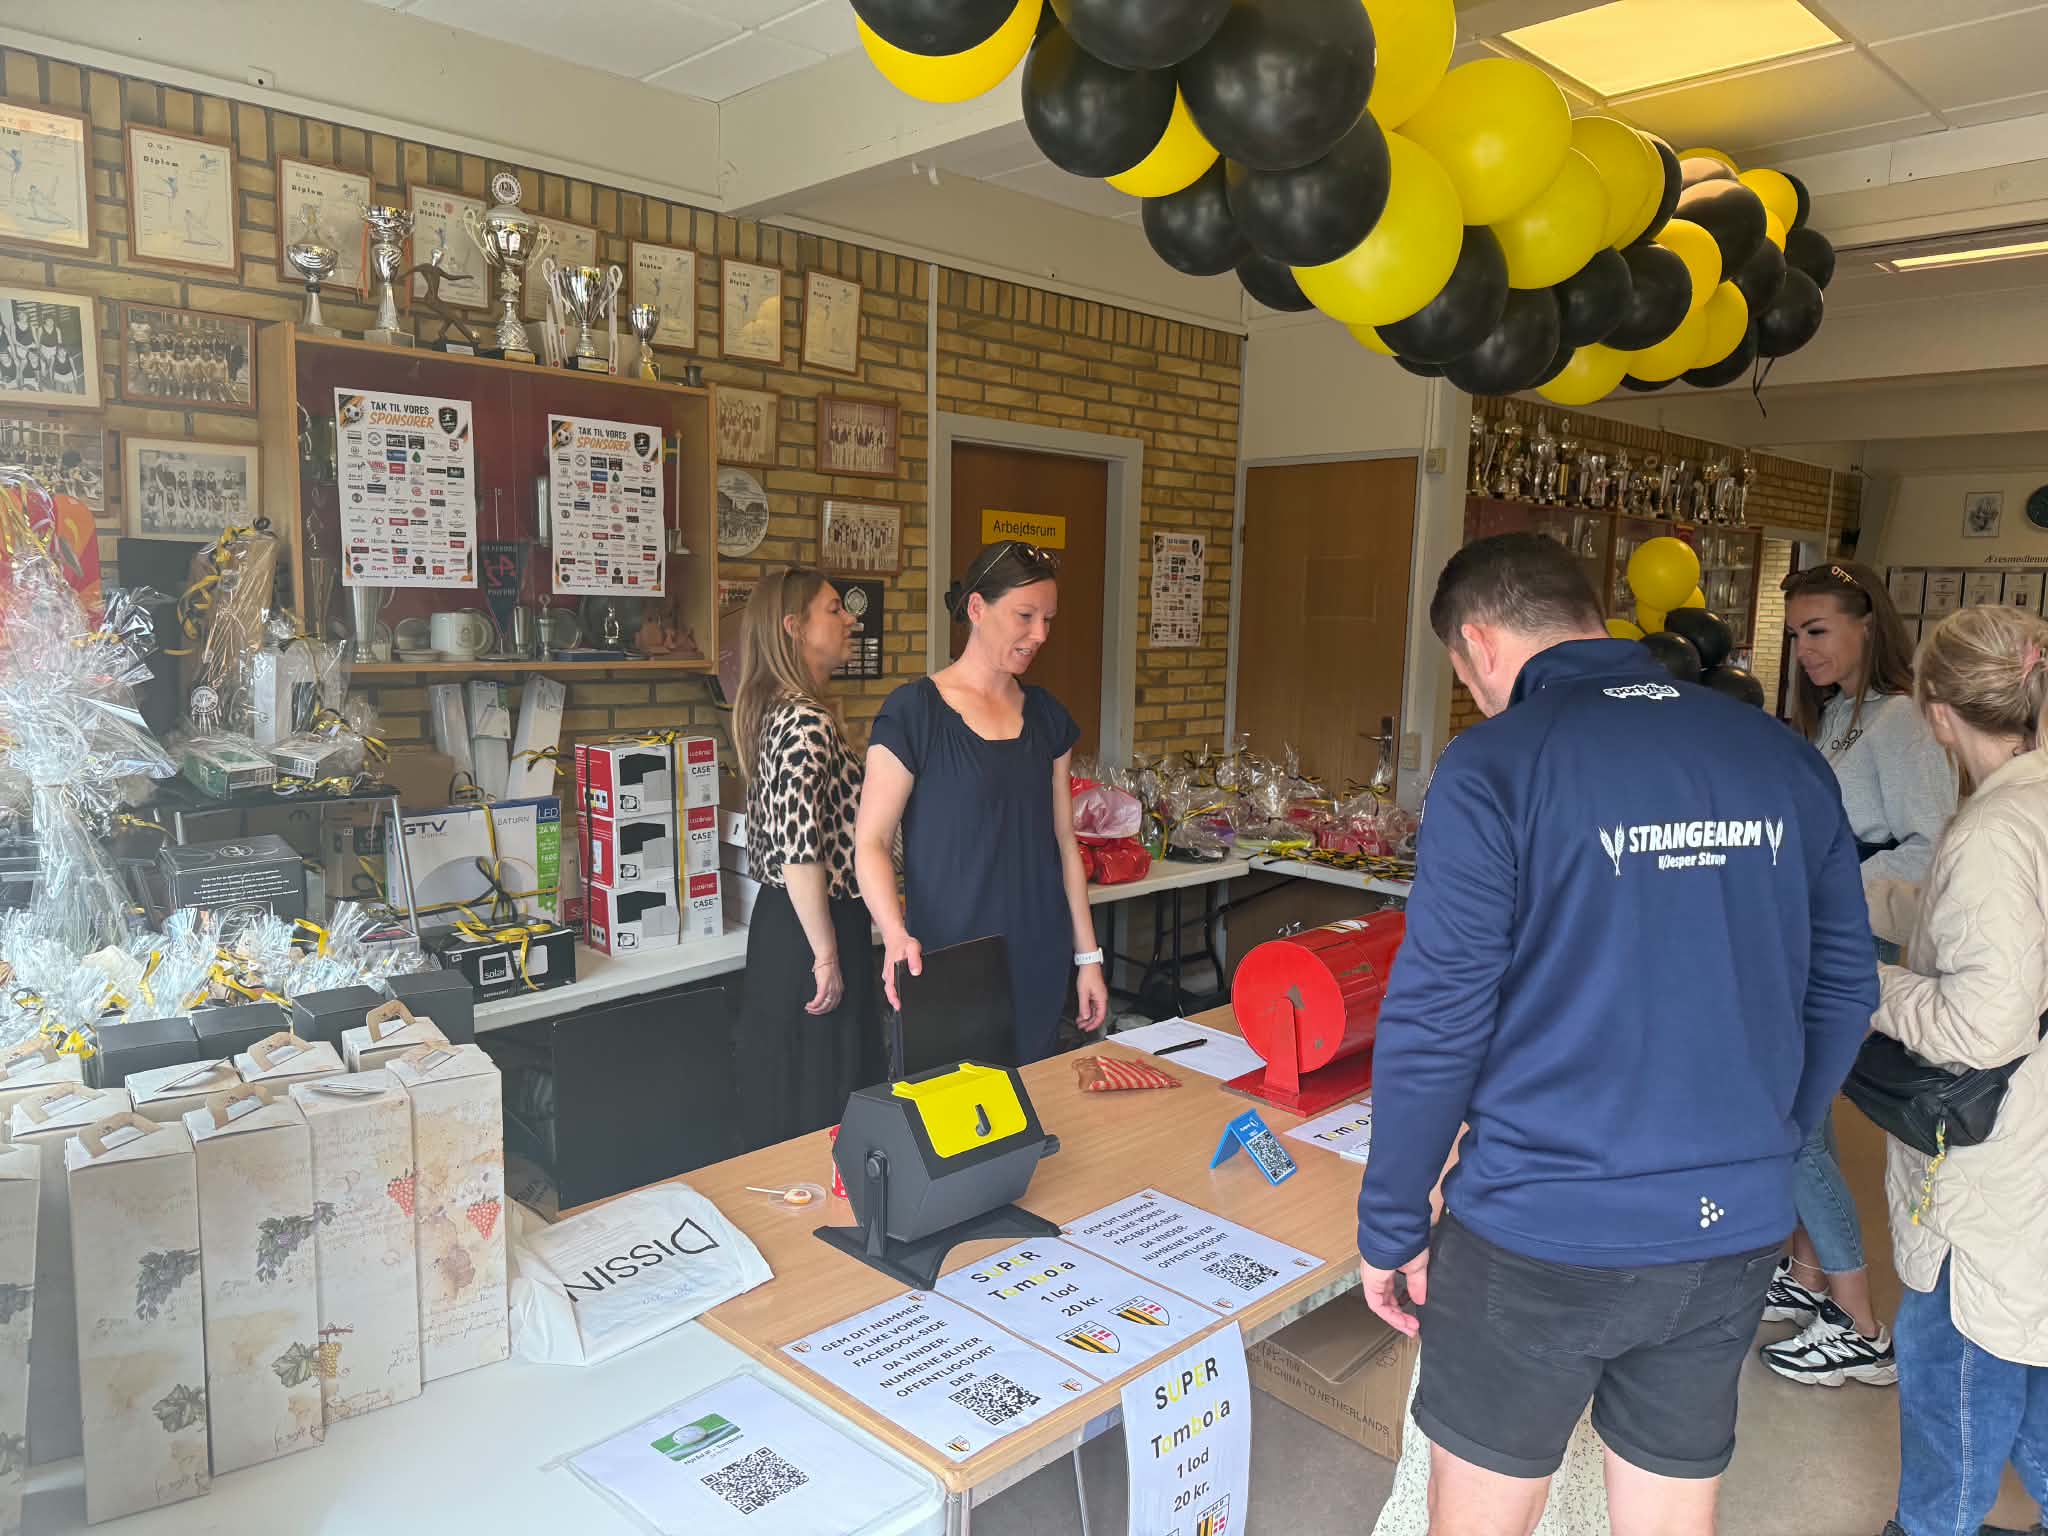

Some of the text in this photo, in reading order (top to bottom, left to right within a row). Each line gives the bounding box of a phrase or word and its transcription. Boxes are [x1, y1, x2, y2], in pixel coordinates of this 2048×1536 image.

[368, 412, 434, 428] SPONSORER
[371, 401, 430, 415] TAK TIL VORES
[576, 436, 631, 451] SPONSORER
[578, 427, 627, 440] TAK TIL VORES
[993, 519, 1056, 537] Arbejdsrum
[692, 766, 711, 775] CASE
[538, 807, 559, 817] LED
[403, 820, 447, 836] GTV
[691, 832, 712, 841] CASE
[693, 898, 713, 909] CASE
[484, 968, 505, 979] solar
[1083, 1224, 1105, 1235] GEM
[1118, 1201, 1158, 1219] NUMMER
[1114, 1213, 1183, 1246] FACEBOOK-SIDE
[1118, 1220, 1139, 1232] LIKE
[1135, 1208, 1166, 1223] VORES
[1142, 1225, 1216, 1262] NUMRENE BLIVER
[1200, 1251, 1221, 1262] DER
[970, 1251, 1042, 1283] SUPER
[987, 1261, 1076, 1301] Tombola
[1040, 1283, 1079, 1303] 1 lod
[1061, 1296, 1104, 1317] 20 kr.
[821, 1304, 924, 1352] GEM DIT NUMMER
[843, 1314, 930, 1357] OG LIKE VORES
[852, 1319, 948, 1367] FACEBOOK-SIDE
[882, 1337, 951, 1371] DA VINDER-
[880, 1336, 983, 1388] NUMRENE BLIVER
[896, 1345, 996, 1397] OFFENTLIGGJORT
[949, 1372, 977, 1387] DER
[1154, 1357, 1219, 1410] SUPER
[1273, 1365, 1301, 1389] CHINA
[1303, 1382, 1316, 1396] TO
[1317, 1388, 1390, 1435] NETHERLANDS
[1151, 1399, 1231, 1458] Tombola
[1177, 1447, 1209, 1479] 1 lod
[1174, 1481, 1210, 1512] 20 kr.
